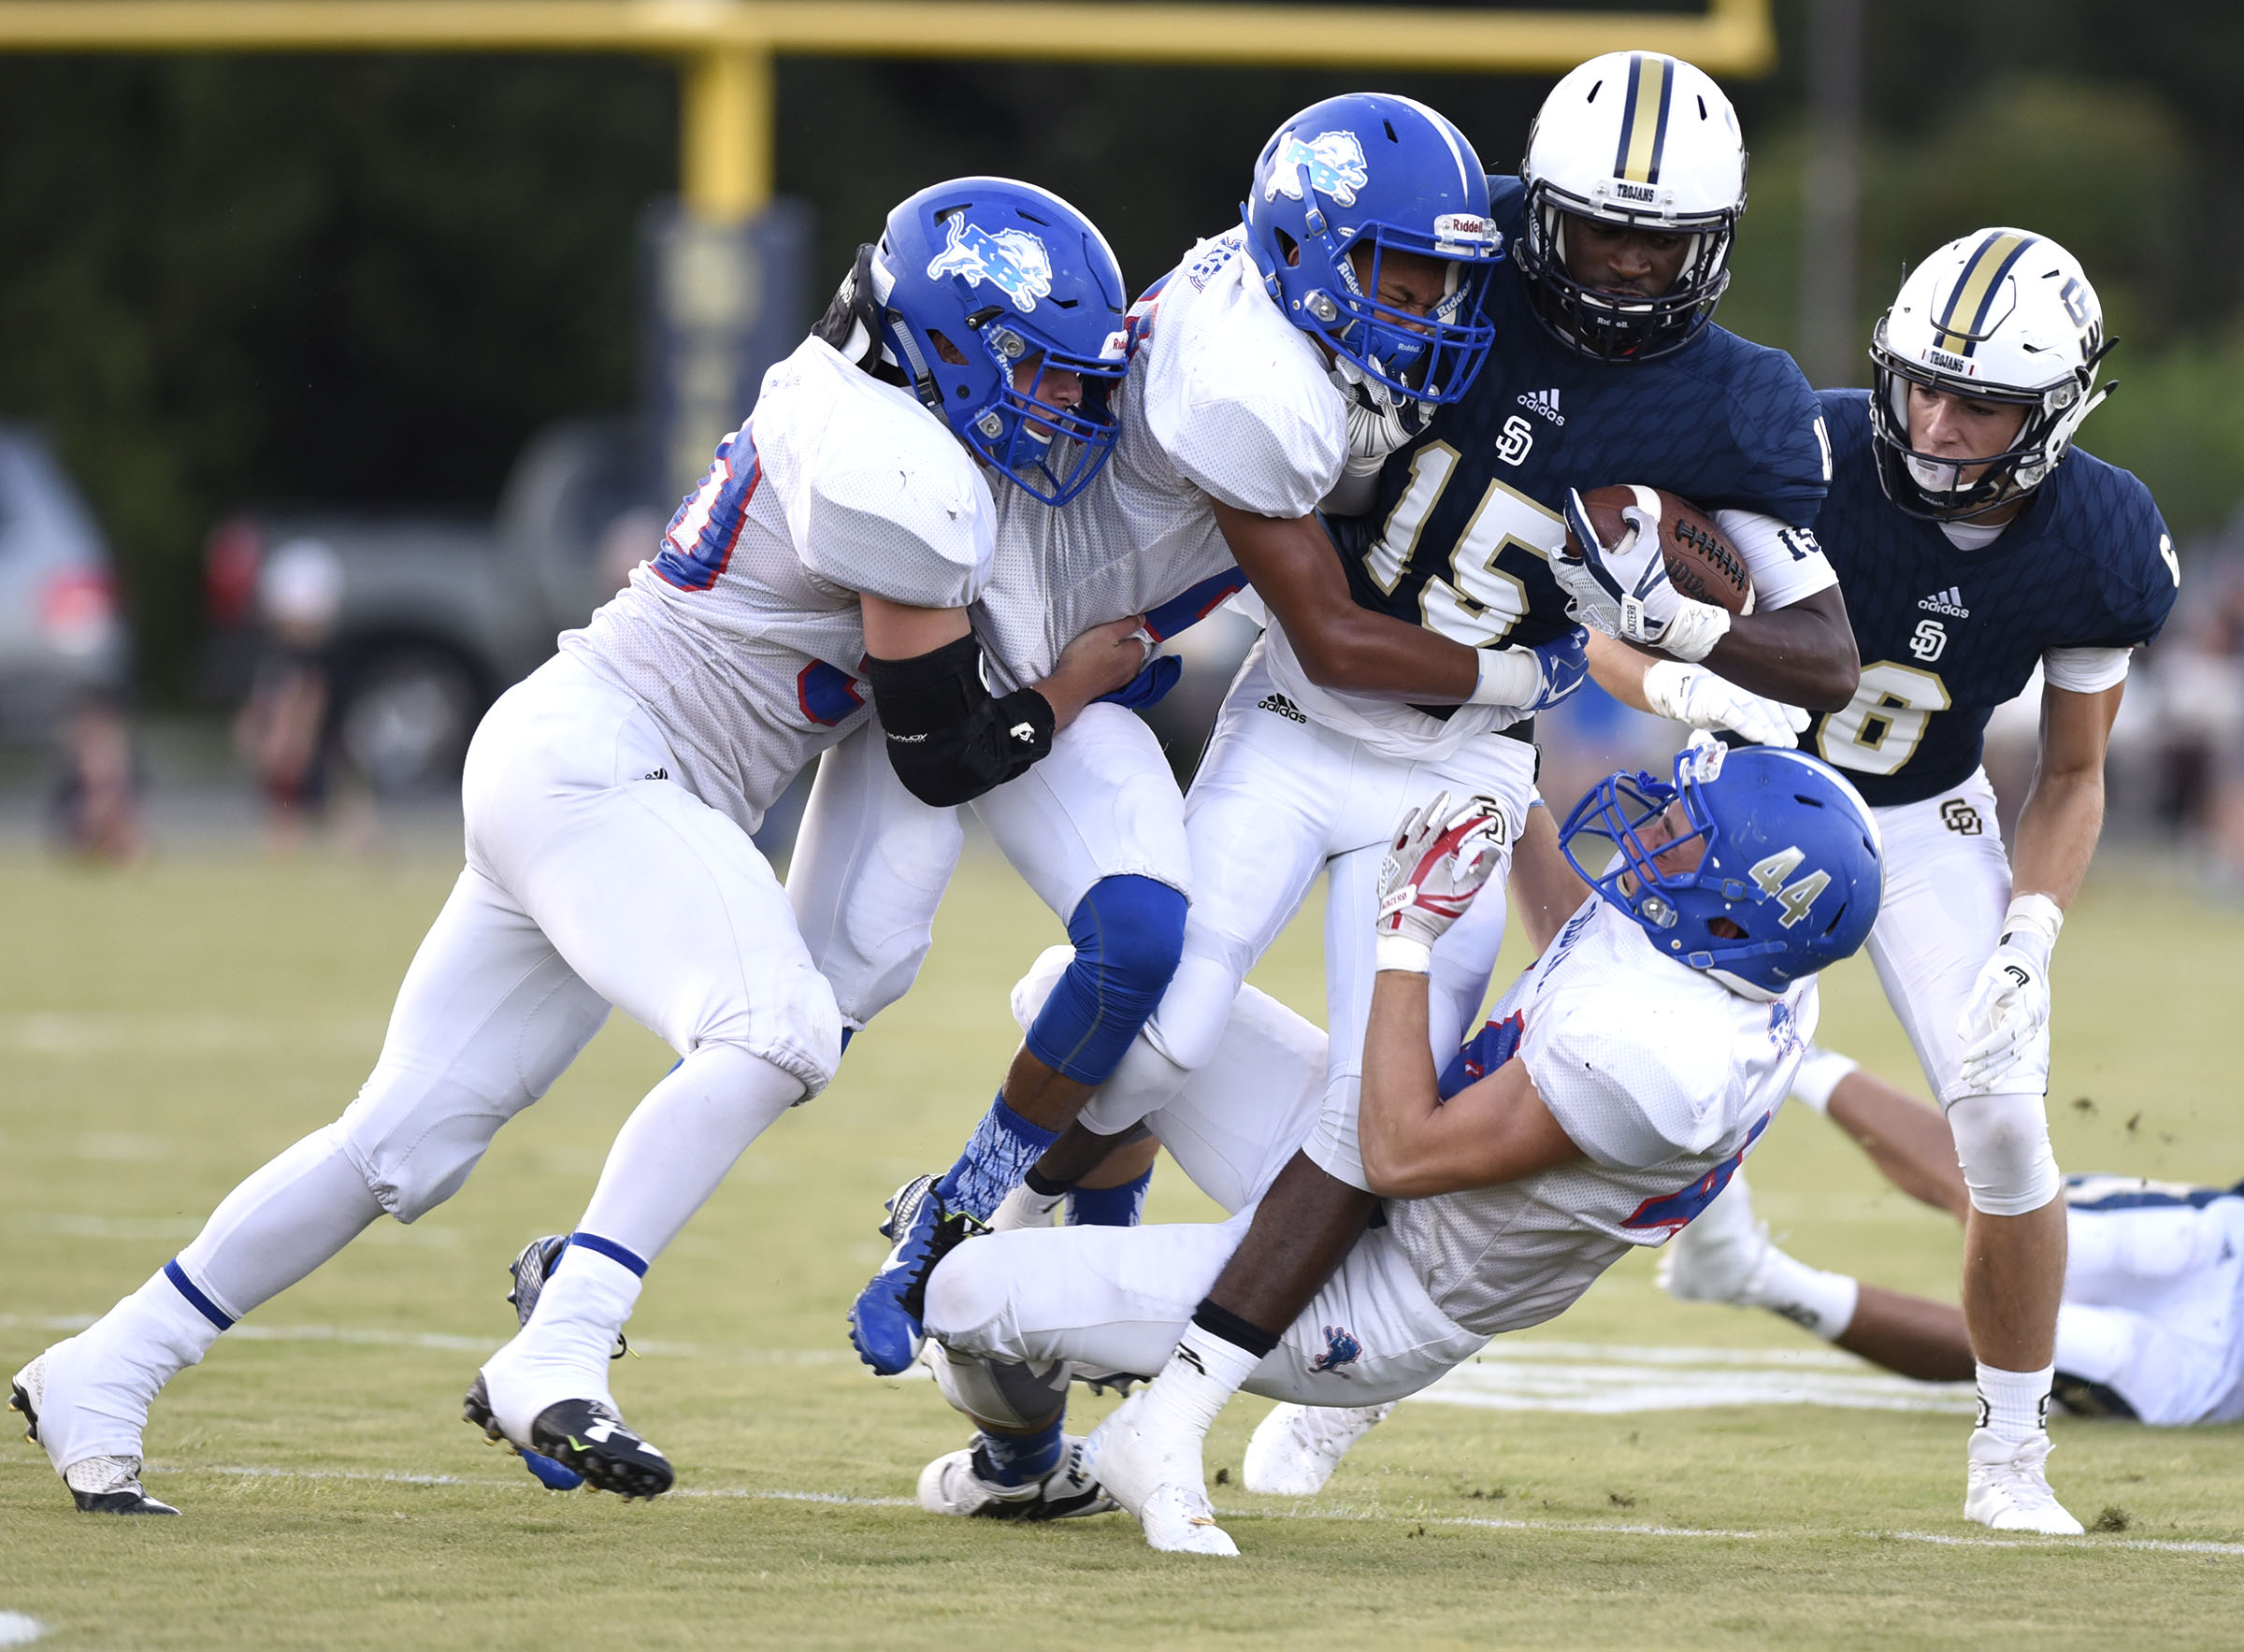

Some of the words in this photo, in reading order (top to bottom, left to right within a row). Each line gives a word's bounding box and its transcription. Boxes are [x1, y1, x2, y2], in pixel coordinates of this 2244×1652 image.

[1617, 183, 1655, 204] TROJANS
[1452, 218, 1485, 234] Riddell
[1597, 316, 1630, 329] Ridell
[1397, 341, 1421, 353] Riddell
[1929, 350, 1965, 372] TROJANS
[1517, 395, 1565, 426] adidas
[1361, 437, 1572, 649] 15
[1918, 596, 1970, 619] adidas
[1257, 700, 1307, 725] adidas
[1816, 658, 1952, 777] 8
[1748, 845, 1833, 929] 44
